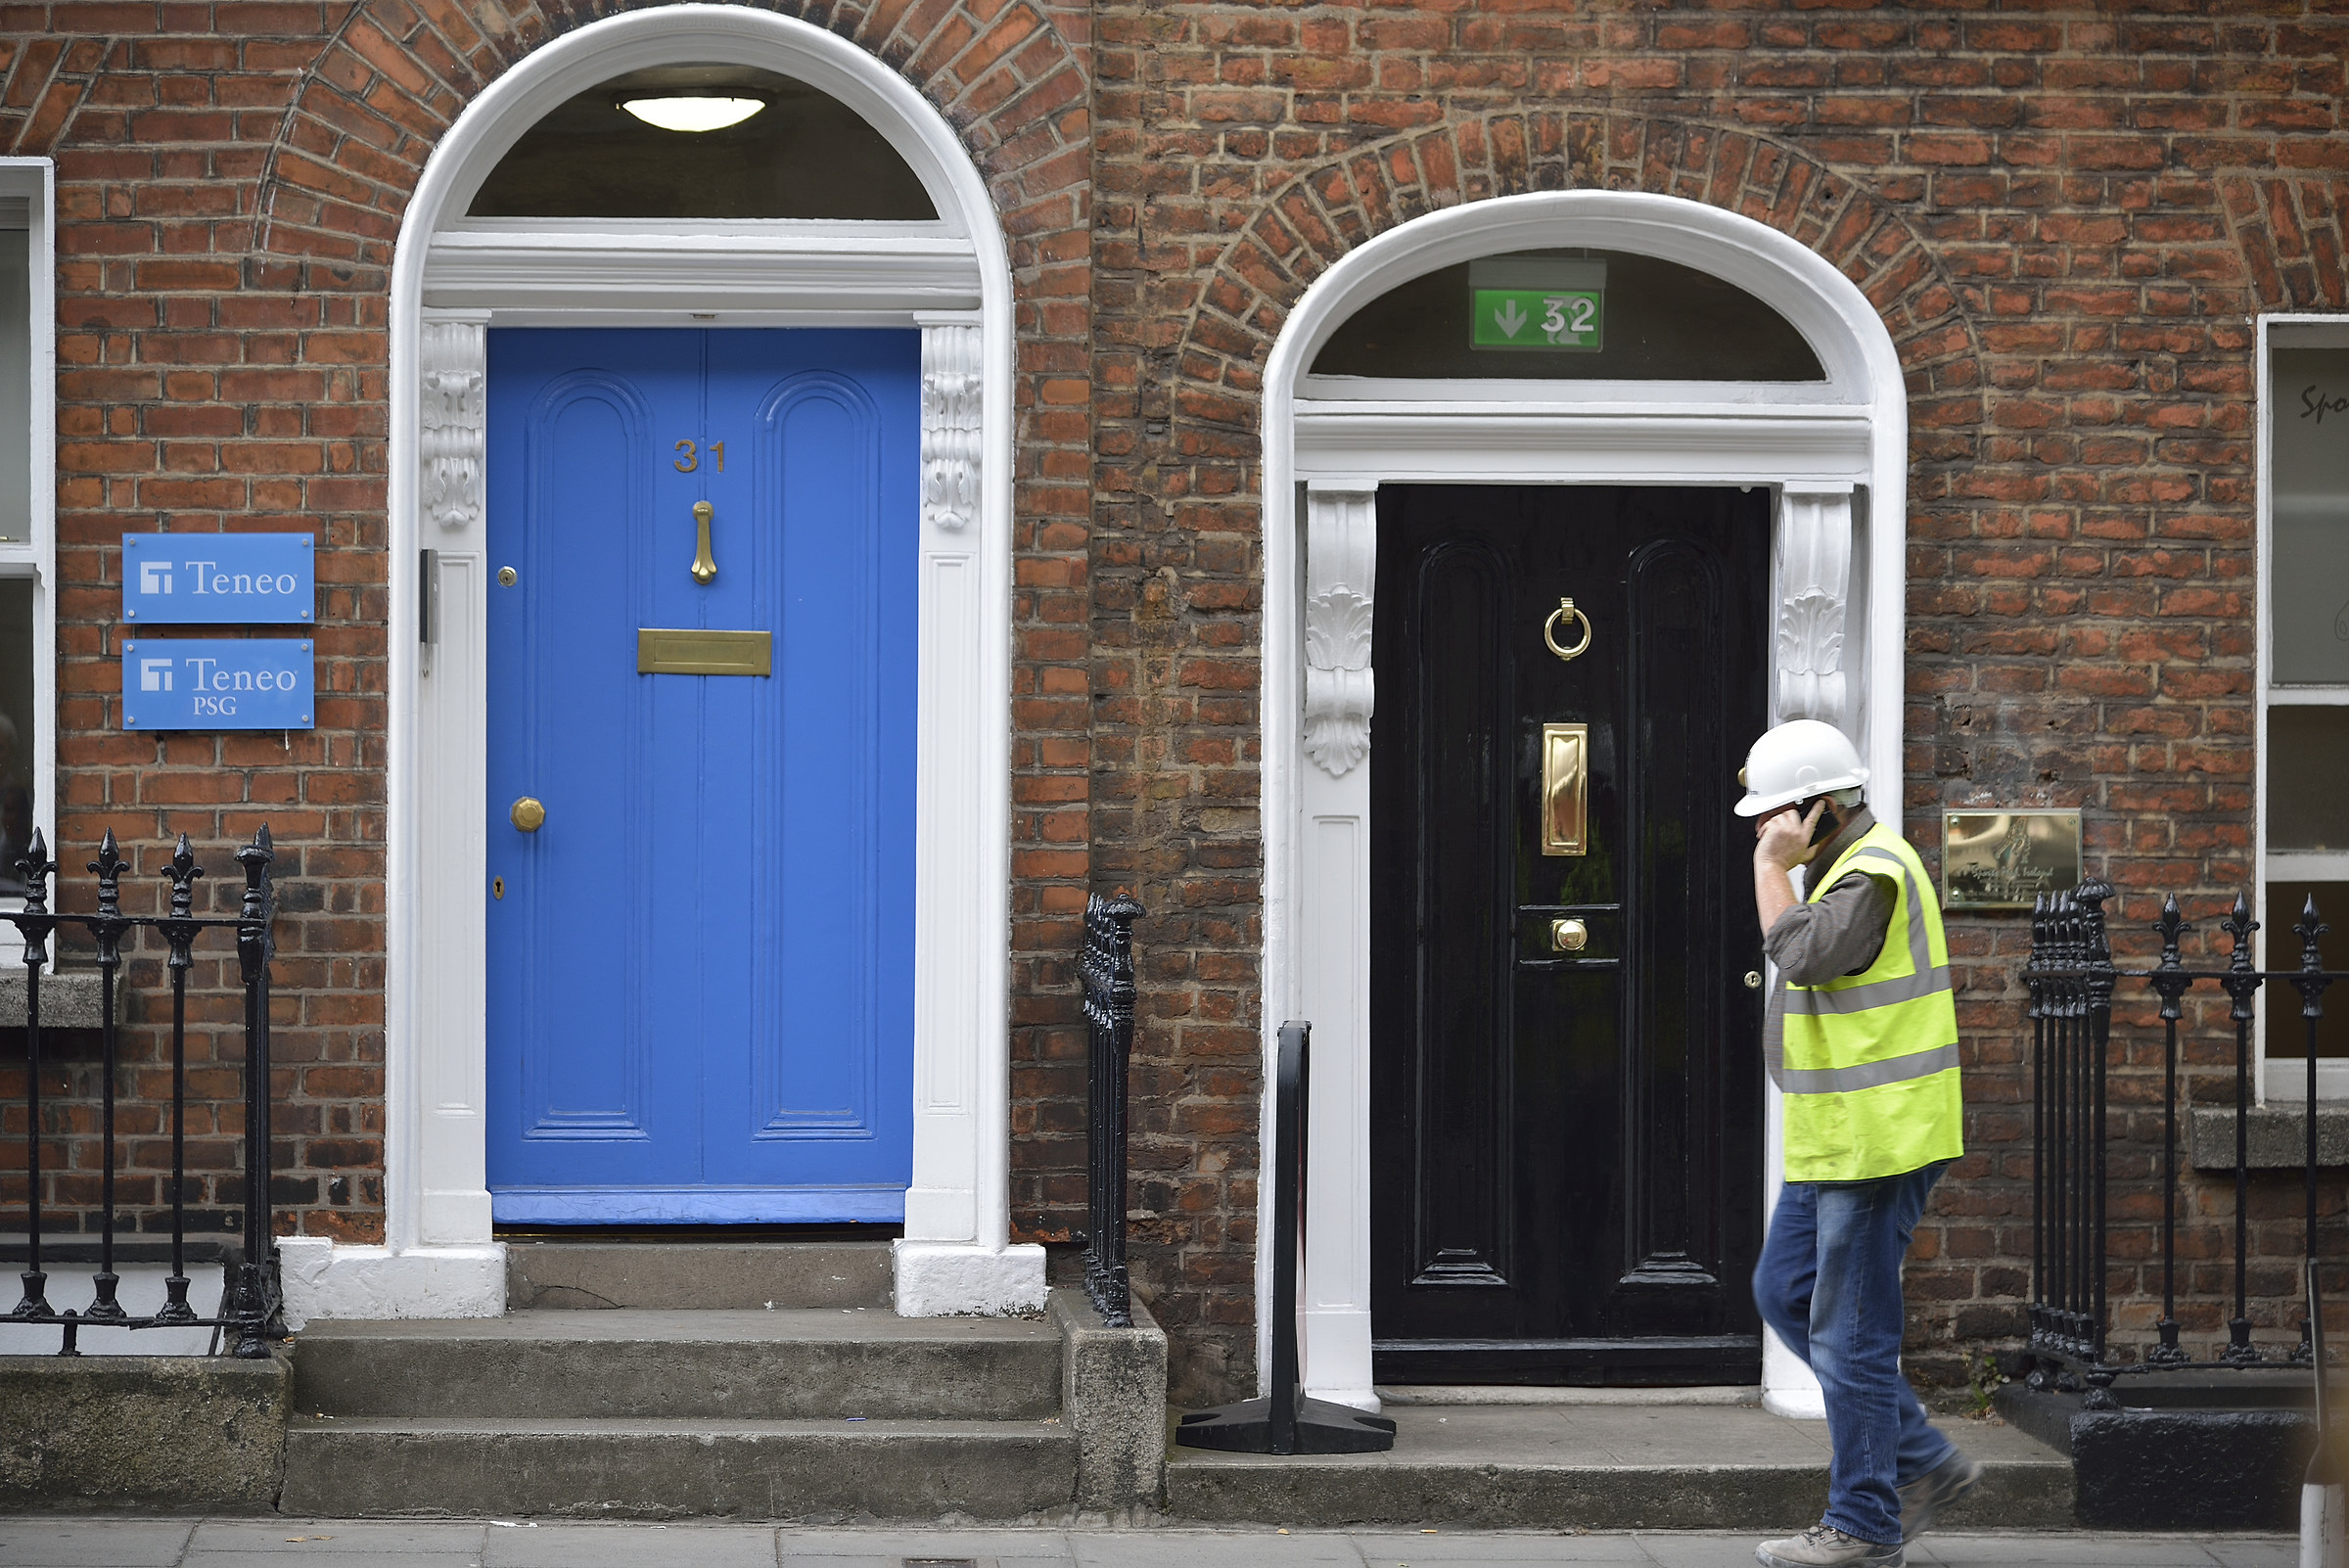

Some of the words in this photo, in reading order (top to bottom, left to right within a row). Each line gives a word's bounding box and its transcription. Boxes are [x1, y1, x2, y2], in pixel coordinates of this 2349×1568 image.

[1541, 297, 1595, 332] 32
[673, 438, 724, 473] 31
[185, 561, 297, 594] Teneo
[185, 658, 297, 691] Teneo
[193, 696, 237, 715] PSG
